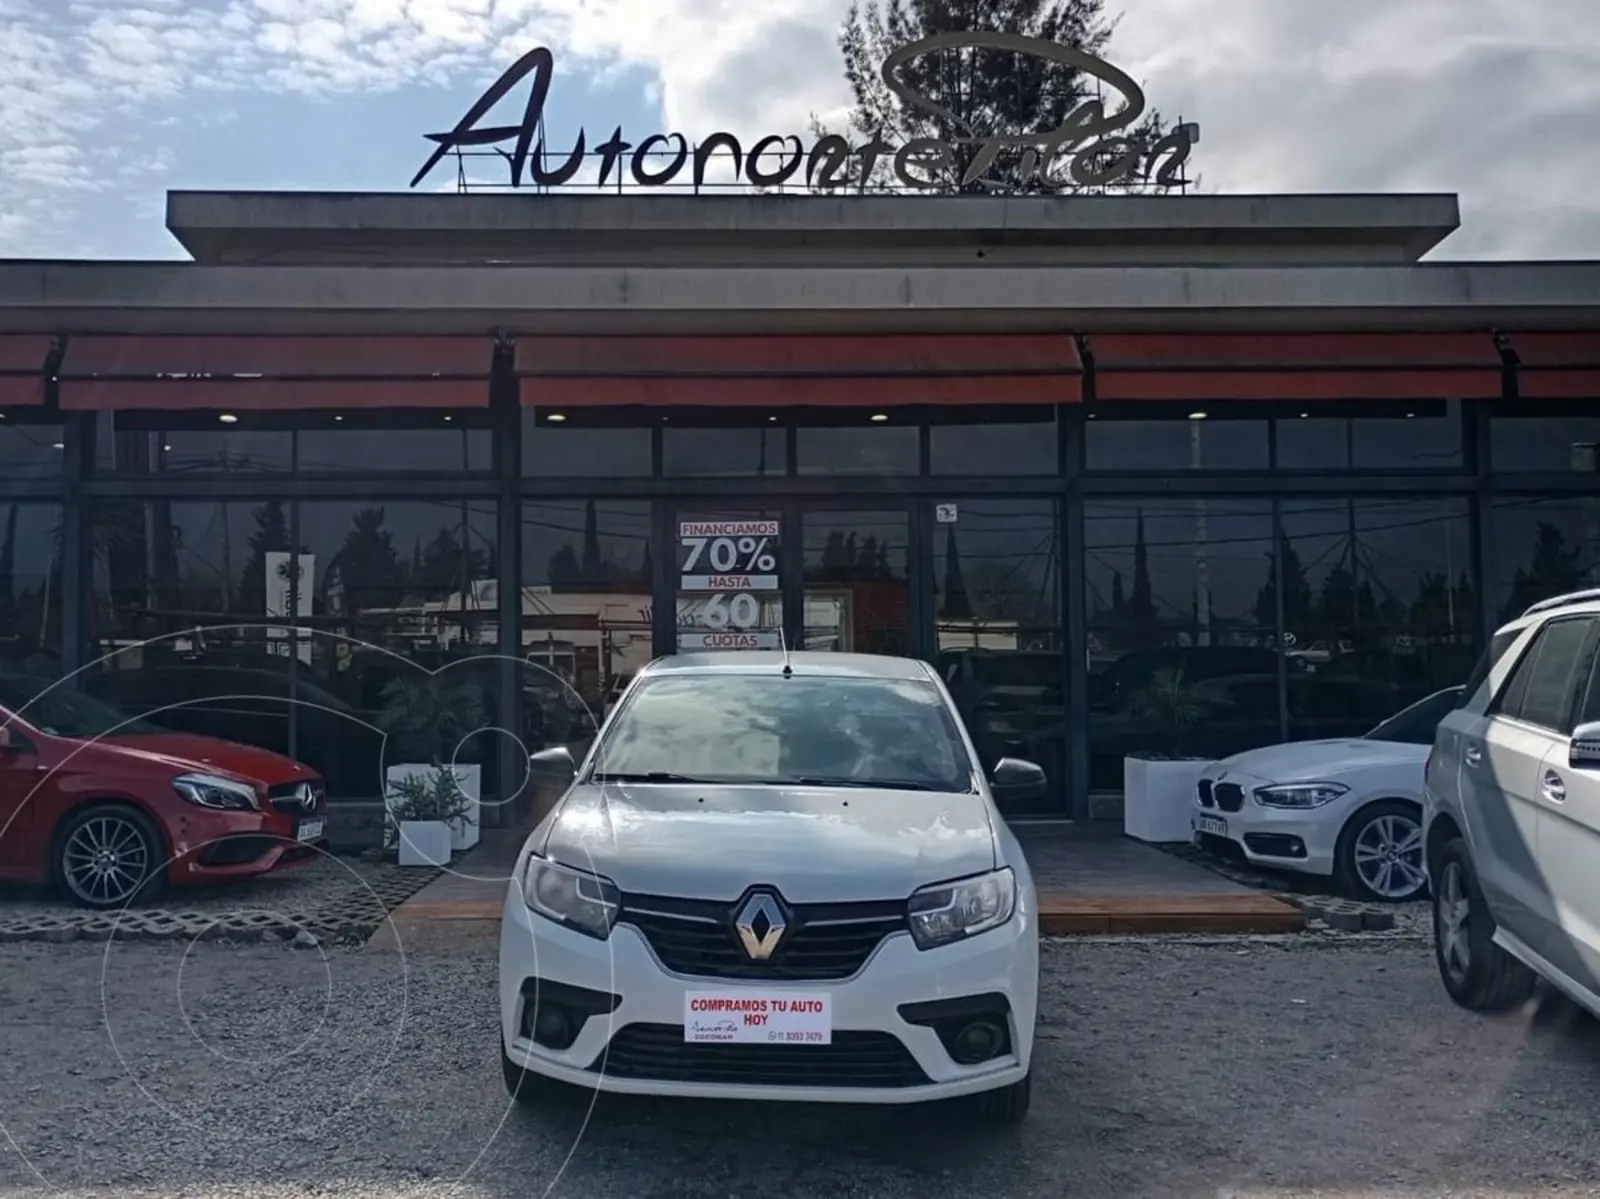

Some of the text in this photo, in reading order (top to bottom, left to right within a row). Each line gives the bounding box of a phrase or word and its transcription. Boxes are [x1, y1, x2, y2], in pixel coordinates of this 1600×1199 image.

[682, 523, 777, 535] FINANCIAMOS
[681, 537, 776, 572] 70%
[708, 577, 751, 588] HASTA
[704, 593, 758, 629] 60
[702, 635, 758, 646] CUOTAS
[691, 1000, 823, 1012] COMPRAMOS TU AUTO
[743, 1014, 768, 1026] HOY
